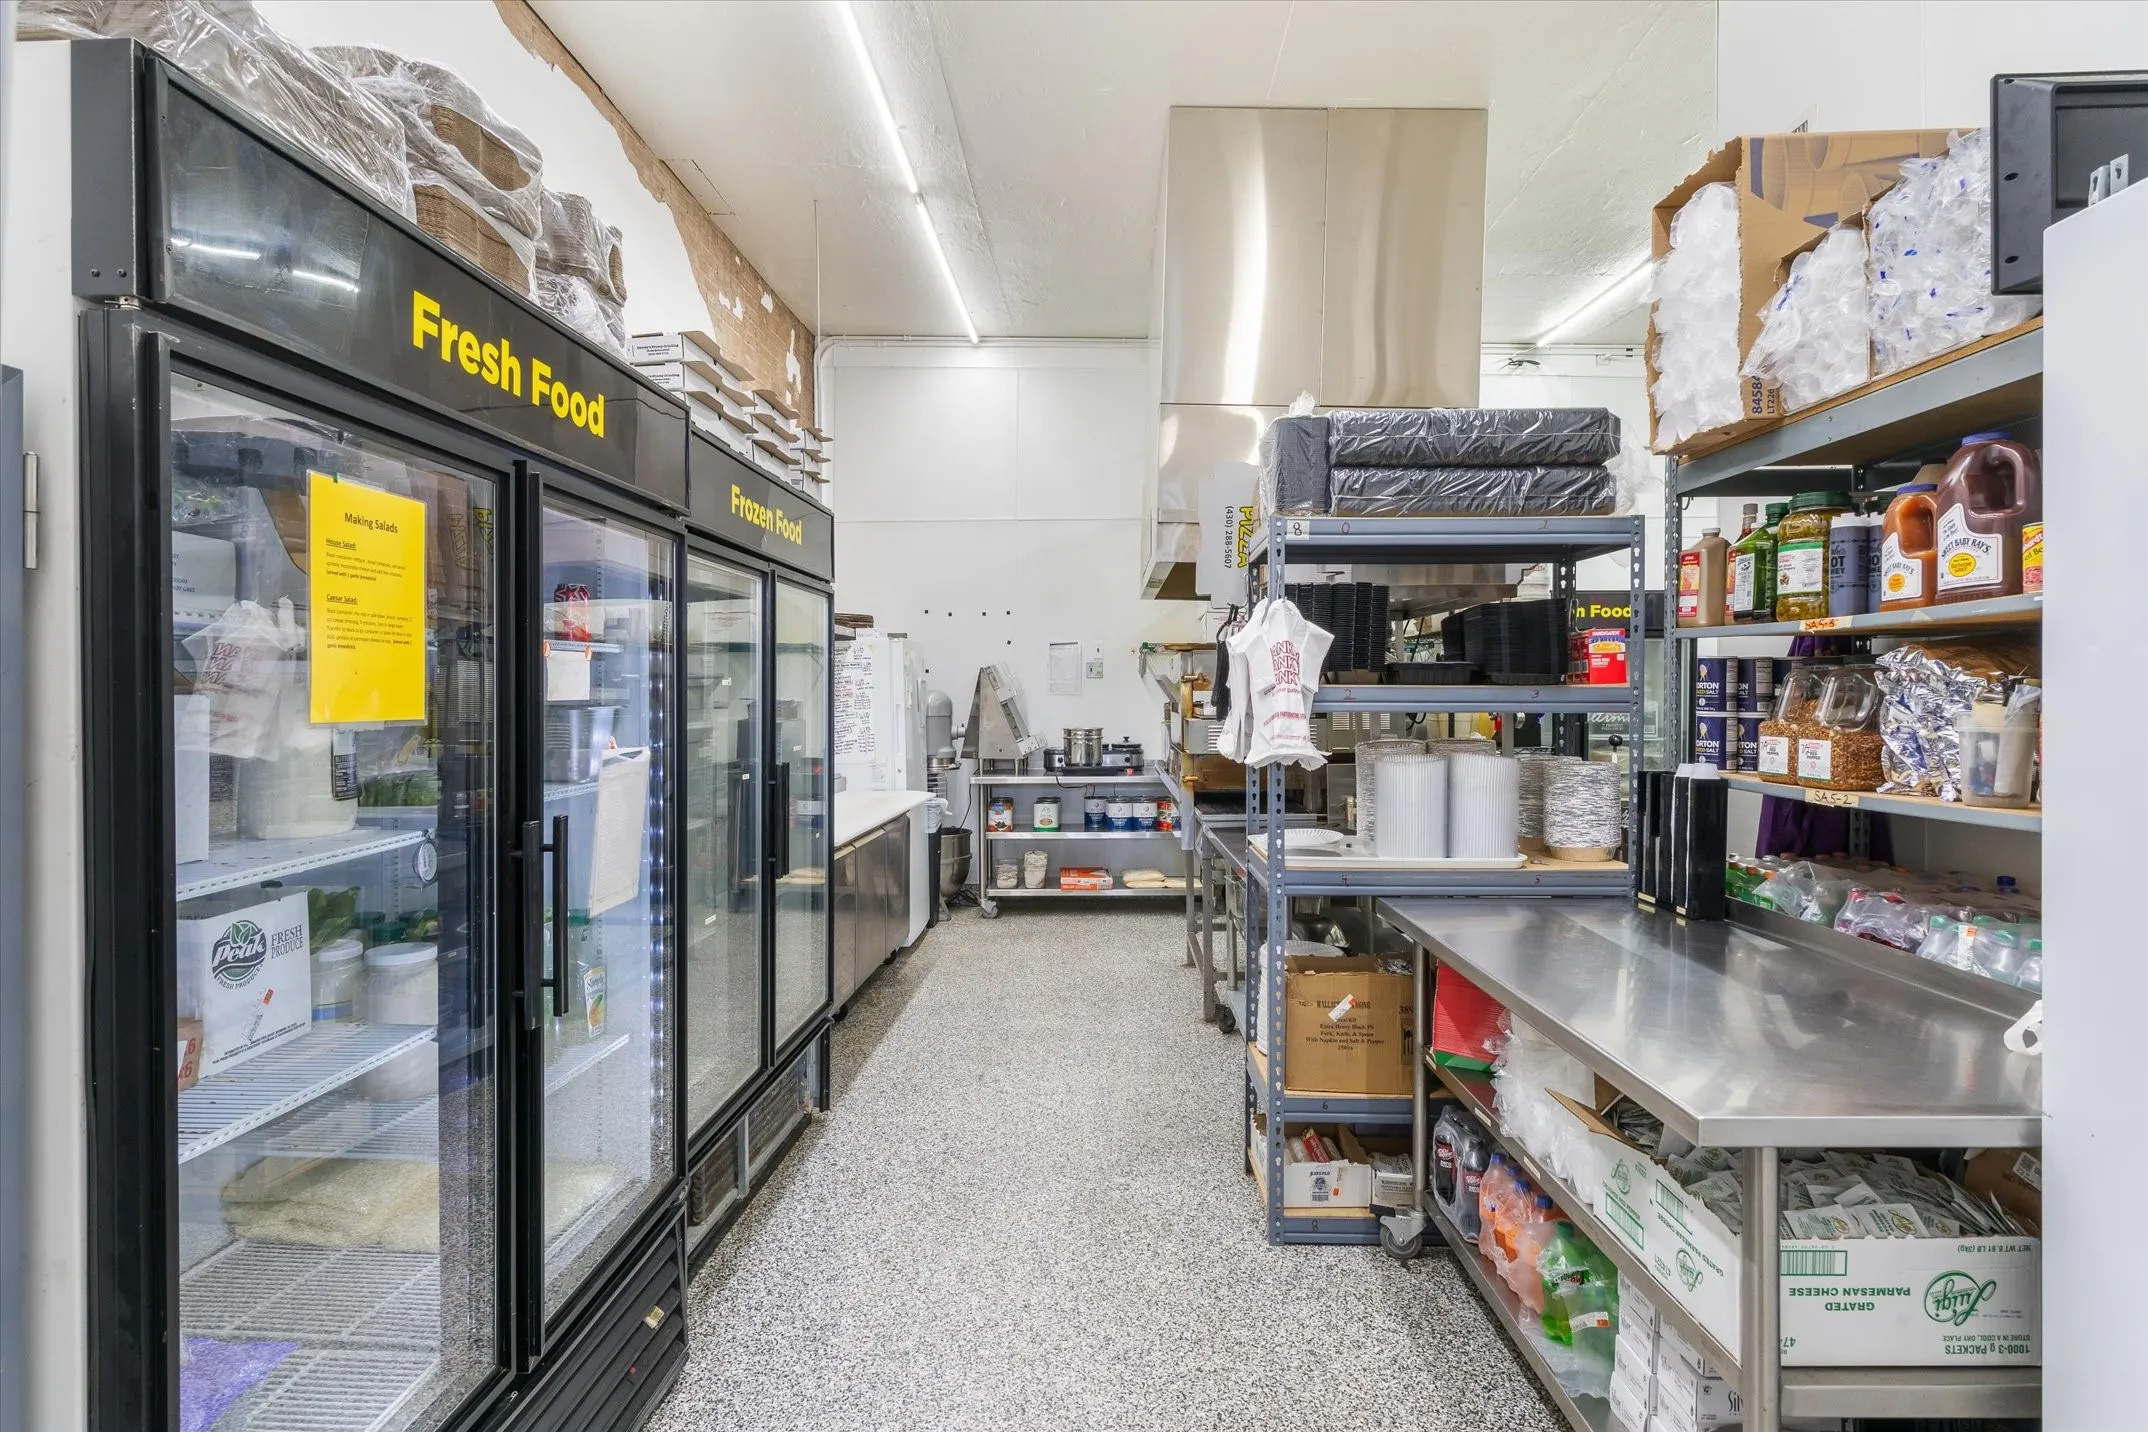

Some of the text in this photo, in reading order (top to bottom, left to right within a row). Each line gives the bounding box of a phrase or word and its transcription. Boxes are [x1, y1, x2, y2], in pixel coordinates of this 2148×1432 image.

[413, 290, 604, 438] Fresh Food
[731, 483, 802, 545] Frozen Food
[344, 512, 398, 534] Making Salads
[1293, 522, 1303, 536] 8
[1224, 505, 1234, 569] (430) 288-5607
[1954, 537, 1971, 548] BABY
[1971, 538, 1992, 555] RAY'S
[1831, 555, 1846, 567] OT
[326, 593, 343, 602] Caesar
[1590, 604, 1632, 618] Food
[1270, 640, 1295, 660] ANK
[1272, 655, 1298, 673] ANK
[1696, 682, 1720, 690] ORTON
[1738, 741, 1758, 749] TON
[271, 925, 303, 946] FRESH
[212, 935, 265, 967] Peak
[271, 936, 303, 959] PRODUCE
[216, 966, 260, 990] FRESH PRODUCE
[1316, 1000, 1340, 1009] WALLAC
[1322, 1099, 1328, 1110] 6
[1675, 1229, 1701, 1258] PARMESAN
[1957, 1244, 1976, 1253] (3kg)
[2004, 1244, 2017, 1252] WT
[1701, 1254, 1724, 1277] GRATED
[1788, 1287, 1911, 1297] PARMESAN CHEESE
[1824, 1301, 1875, 1311] GRATED
[1932, 1278, 1997, 1327] Luigi
[2010, 1334, 2031, 1342] STORE
[1945, 1343, 1987, 1354] PACKETS
[1997, 1344, 2031, 1354] 1000-3
